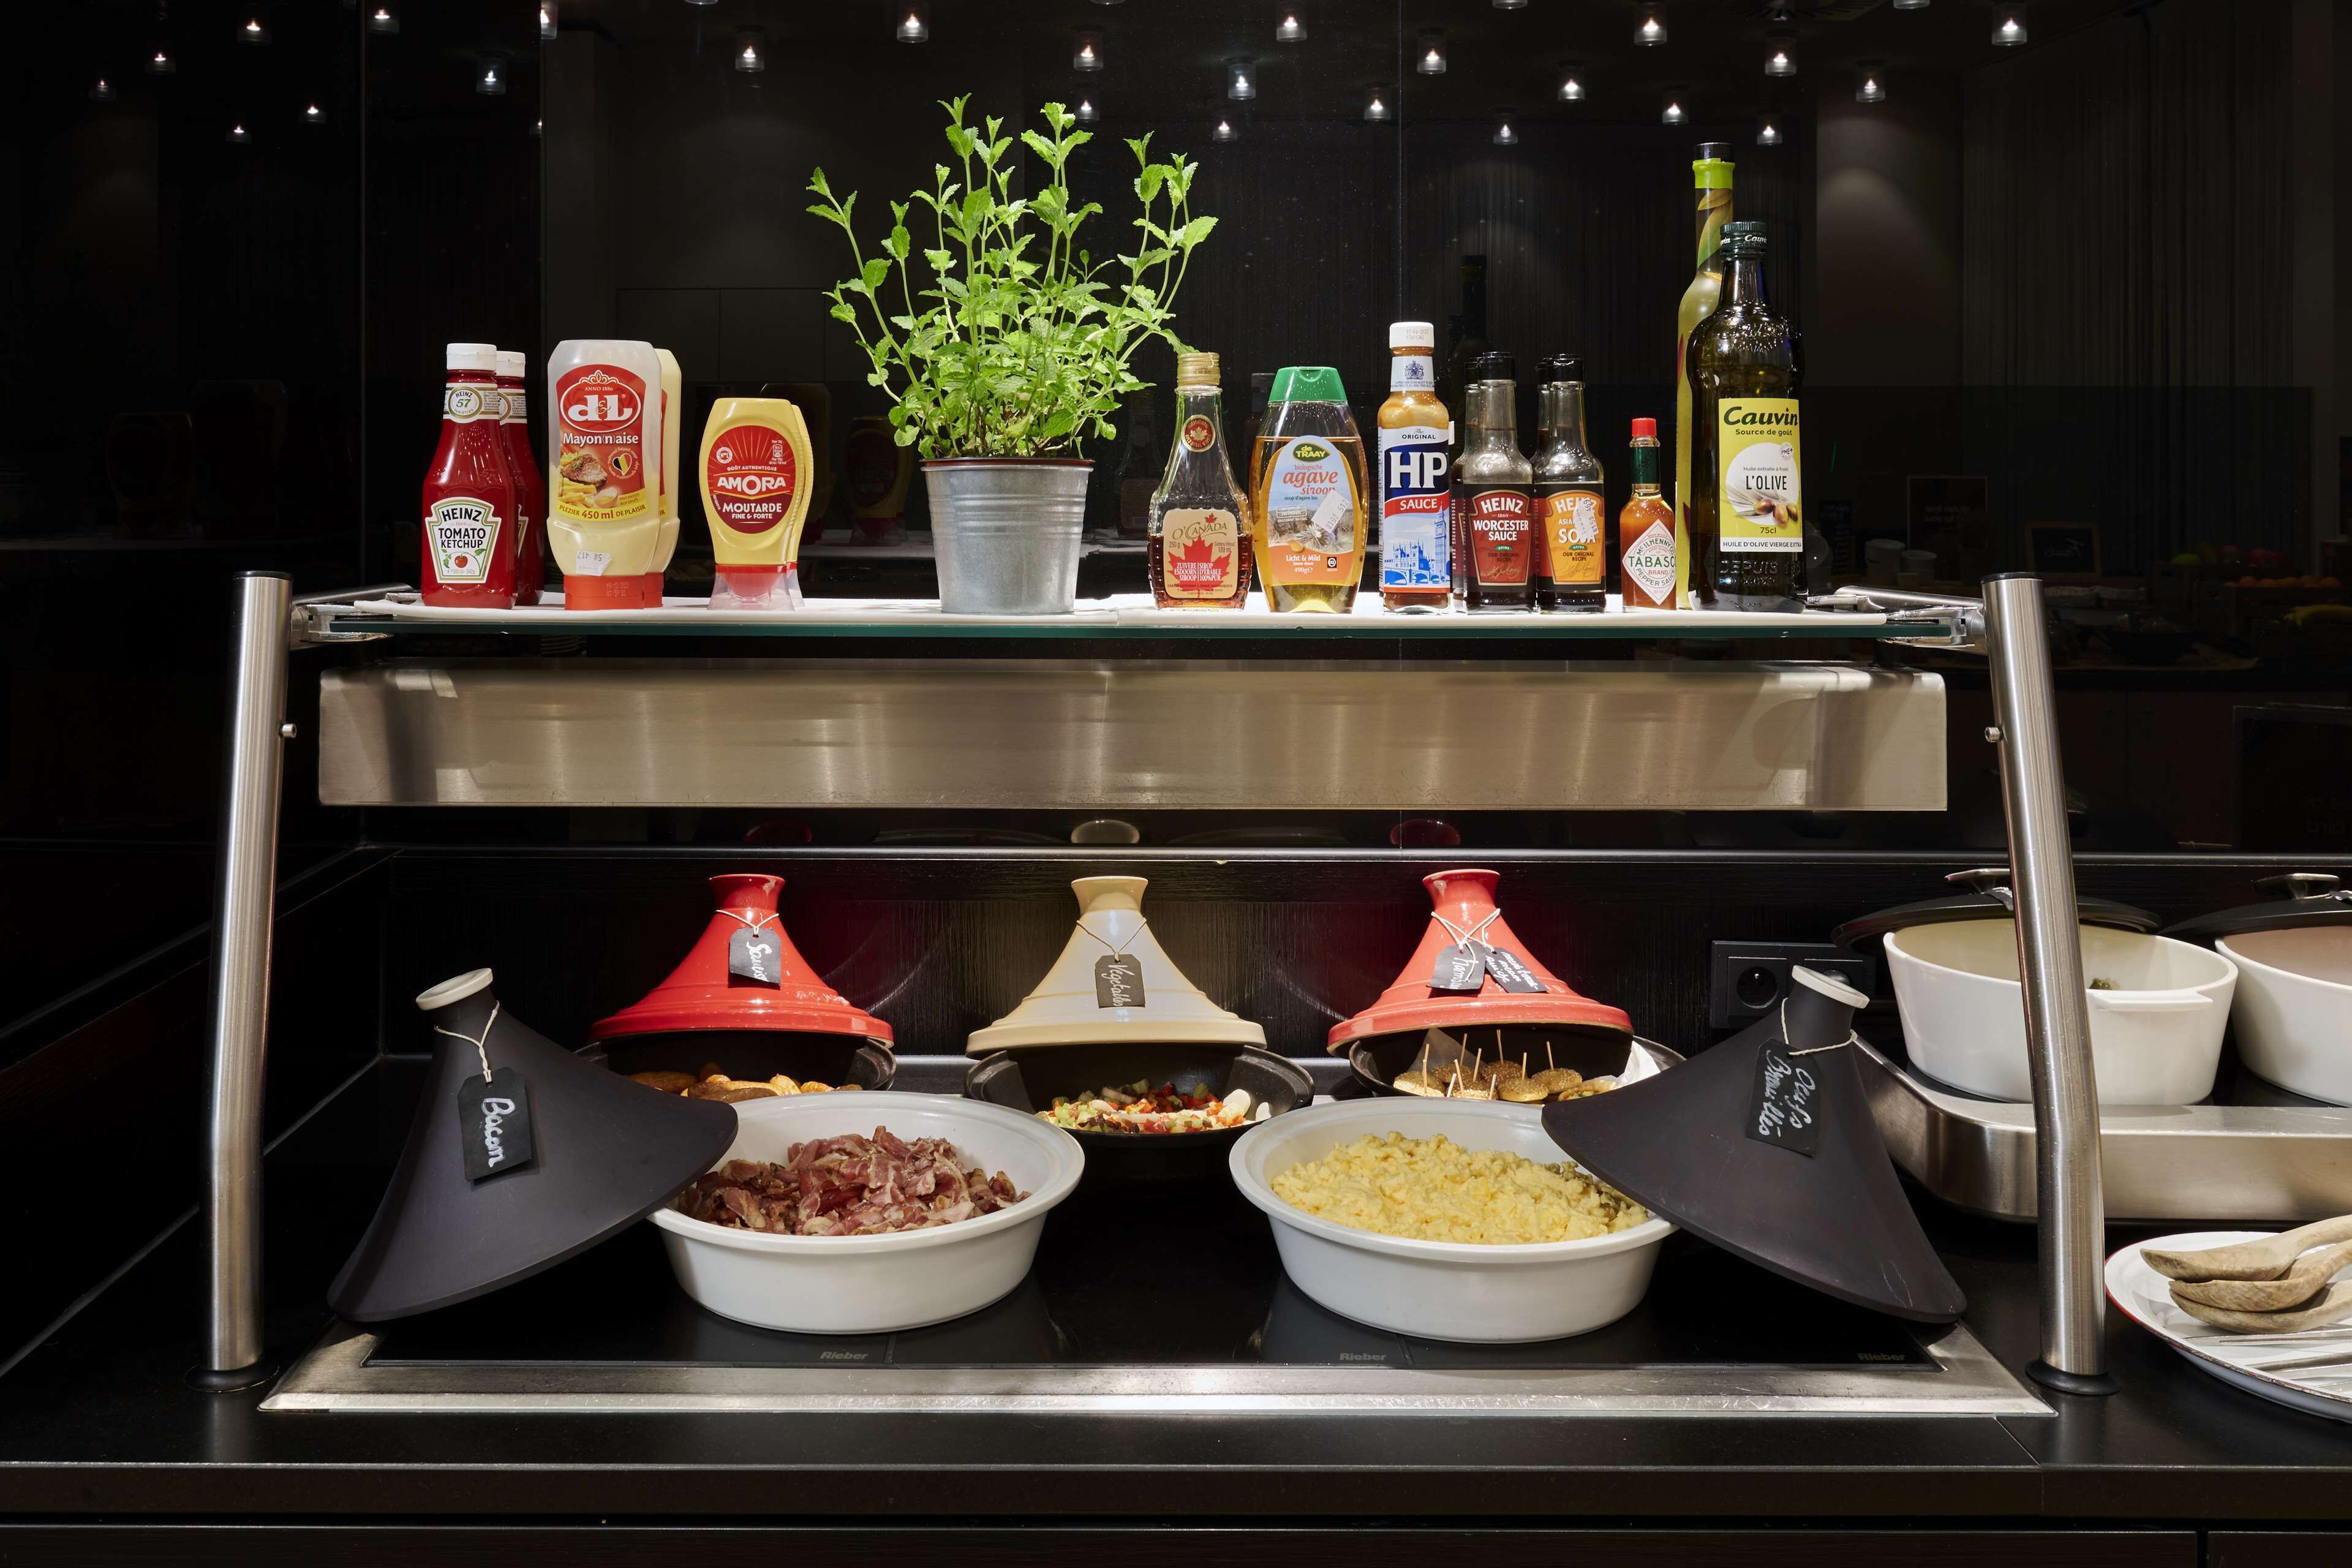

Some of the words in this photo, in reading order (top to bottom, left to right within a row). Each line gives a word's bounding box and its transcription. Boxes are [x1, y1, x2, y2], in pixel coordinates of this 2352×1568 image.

[456, 399, 472, 408] 57
[1724, 406, 1798, 426] Cauvin
[563, 432, 639, 447] Mayon(n)aise
[1390, 451, 1447, 488] HP
[717, 475, 786, 495] AMORA
[1283, 470, 1338, 488] agave
[1746, 475, 1787, 490] L'OLIVE
[723, 502, 782, 513] MOUTARDE
[1400, 499, 1438, 510] SAUCE
[1480, 497, 1523, 514] HEINZ
[441, 508, 482, 522] HEINZ
[559, 505, 579, 516] PLEZIER
[582, 510, 599, 519] 450
[601, 510, 614, 519] ml
[625, 505, 646, 516] PLAISIR
[1172, 521, 1227, 540] O'CANADA
[1473, 520, 1529, 531] WORCESTER
[439, 528, 486, 539] TOMATO
[1488, 532, 1517, 541] SAUCE
[441, 540, 483, 548] KETCHUP
[1628, 556, 1676, 568] TABASC
[1637, 568, 1660, 587] PEPPER
[482, 1098, 516, 1167] Bacon
